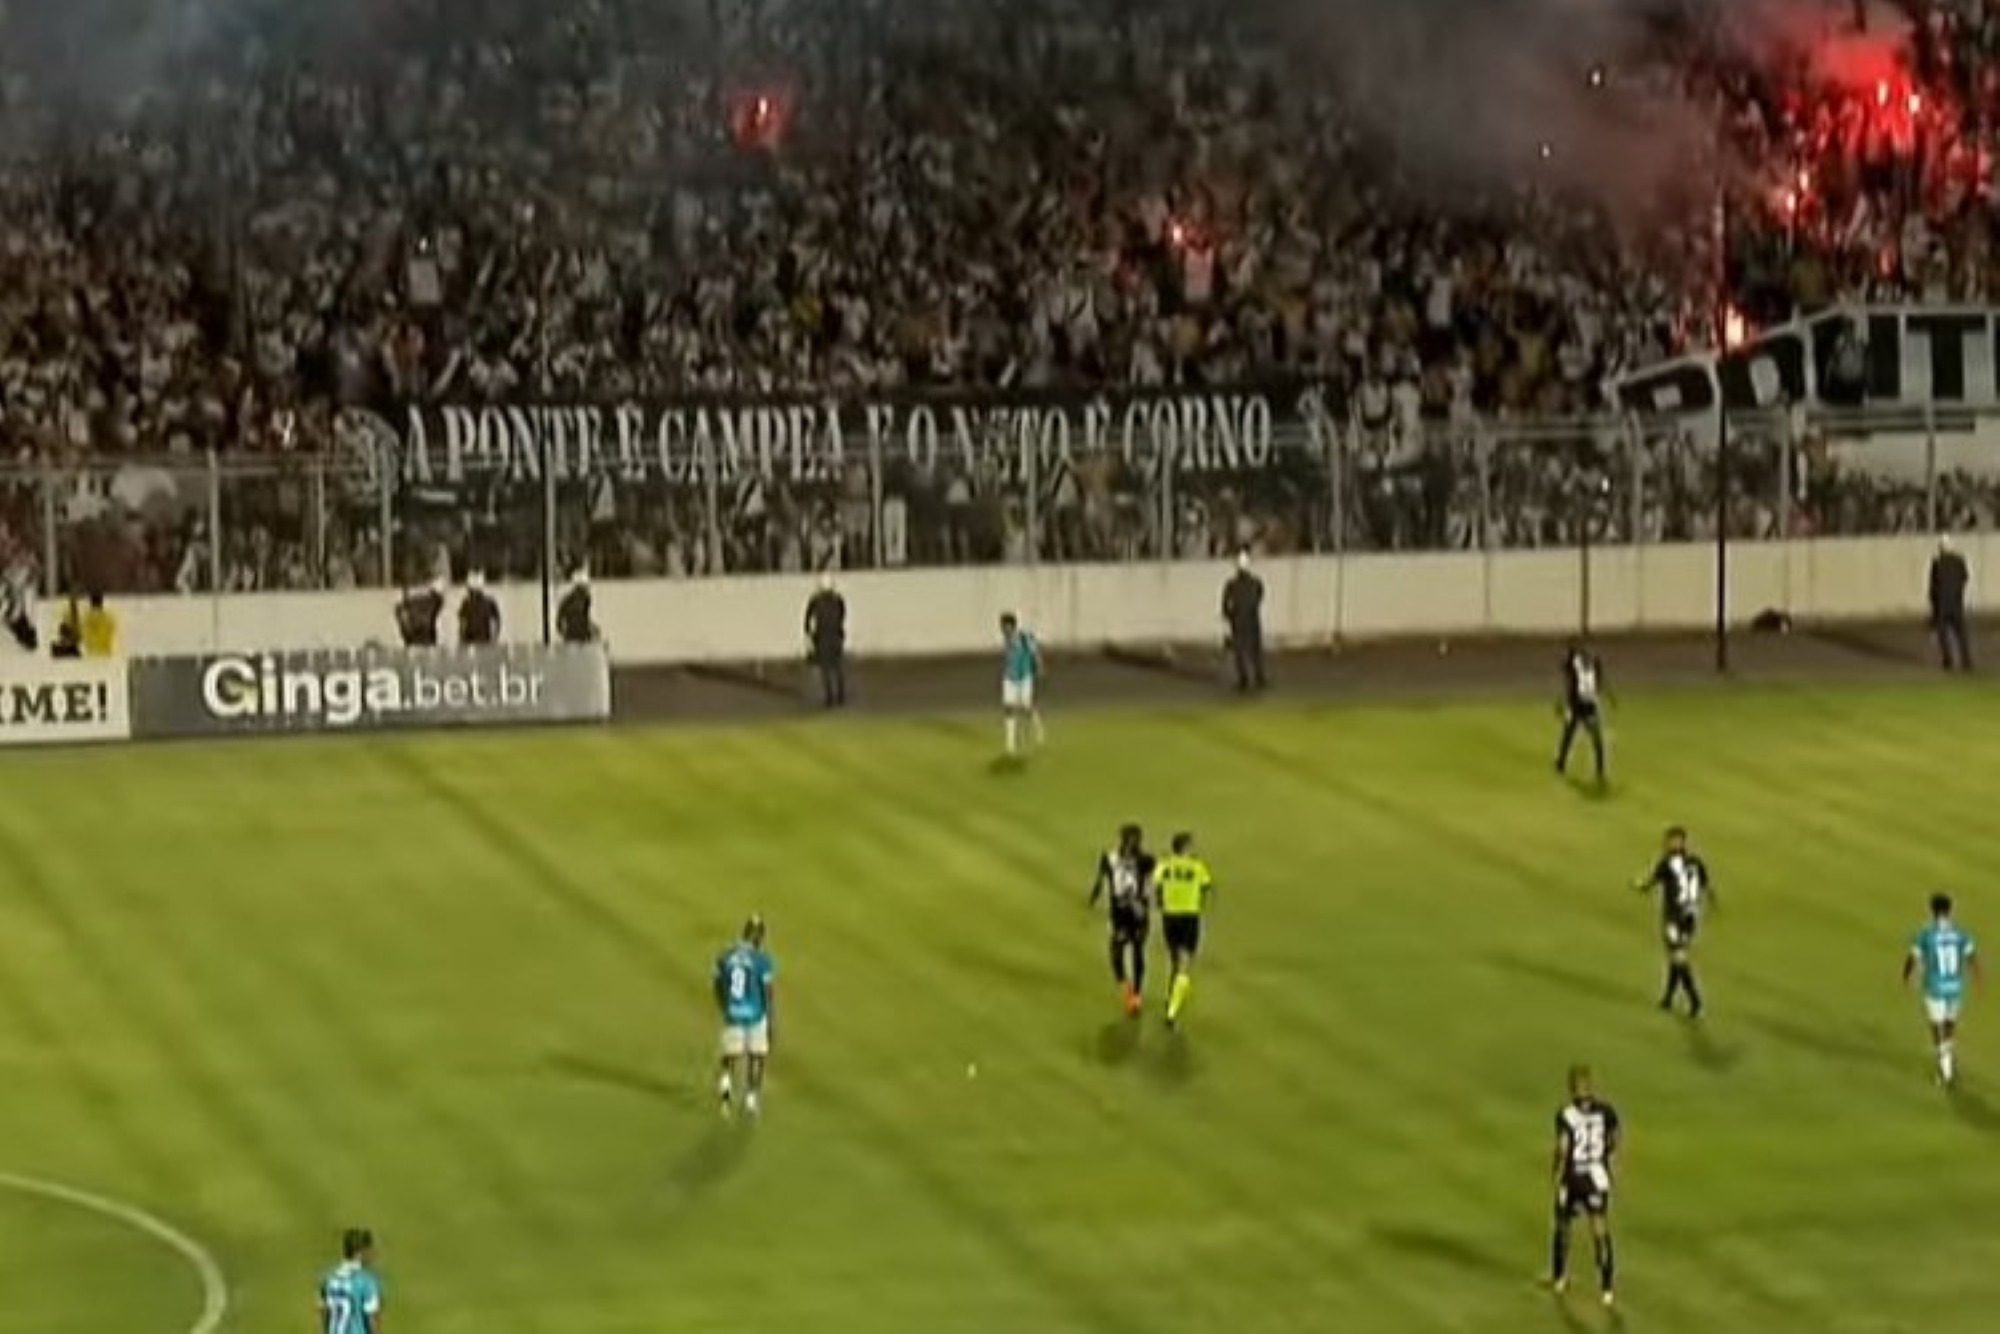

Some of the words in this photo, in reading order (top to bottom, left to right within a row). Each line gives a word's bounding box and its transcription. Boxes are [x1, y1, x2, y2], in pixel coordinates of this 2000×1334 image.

[403, 404, 432, 476] A
[440, 403, 602, 478] PONTE
[203, 656, 544, 724] Ginga.bet.br
